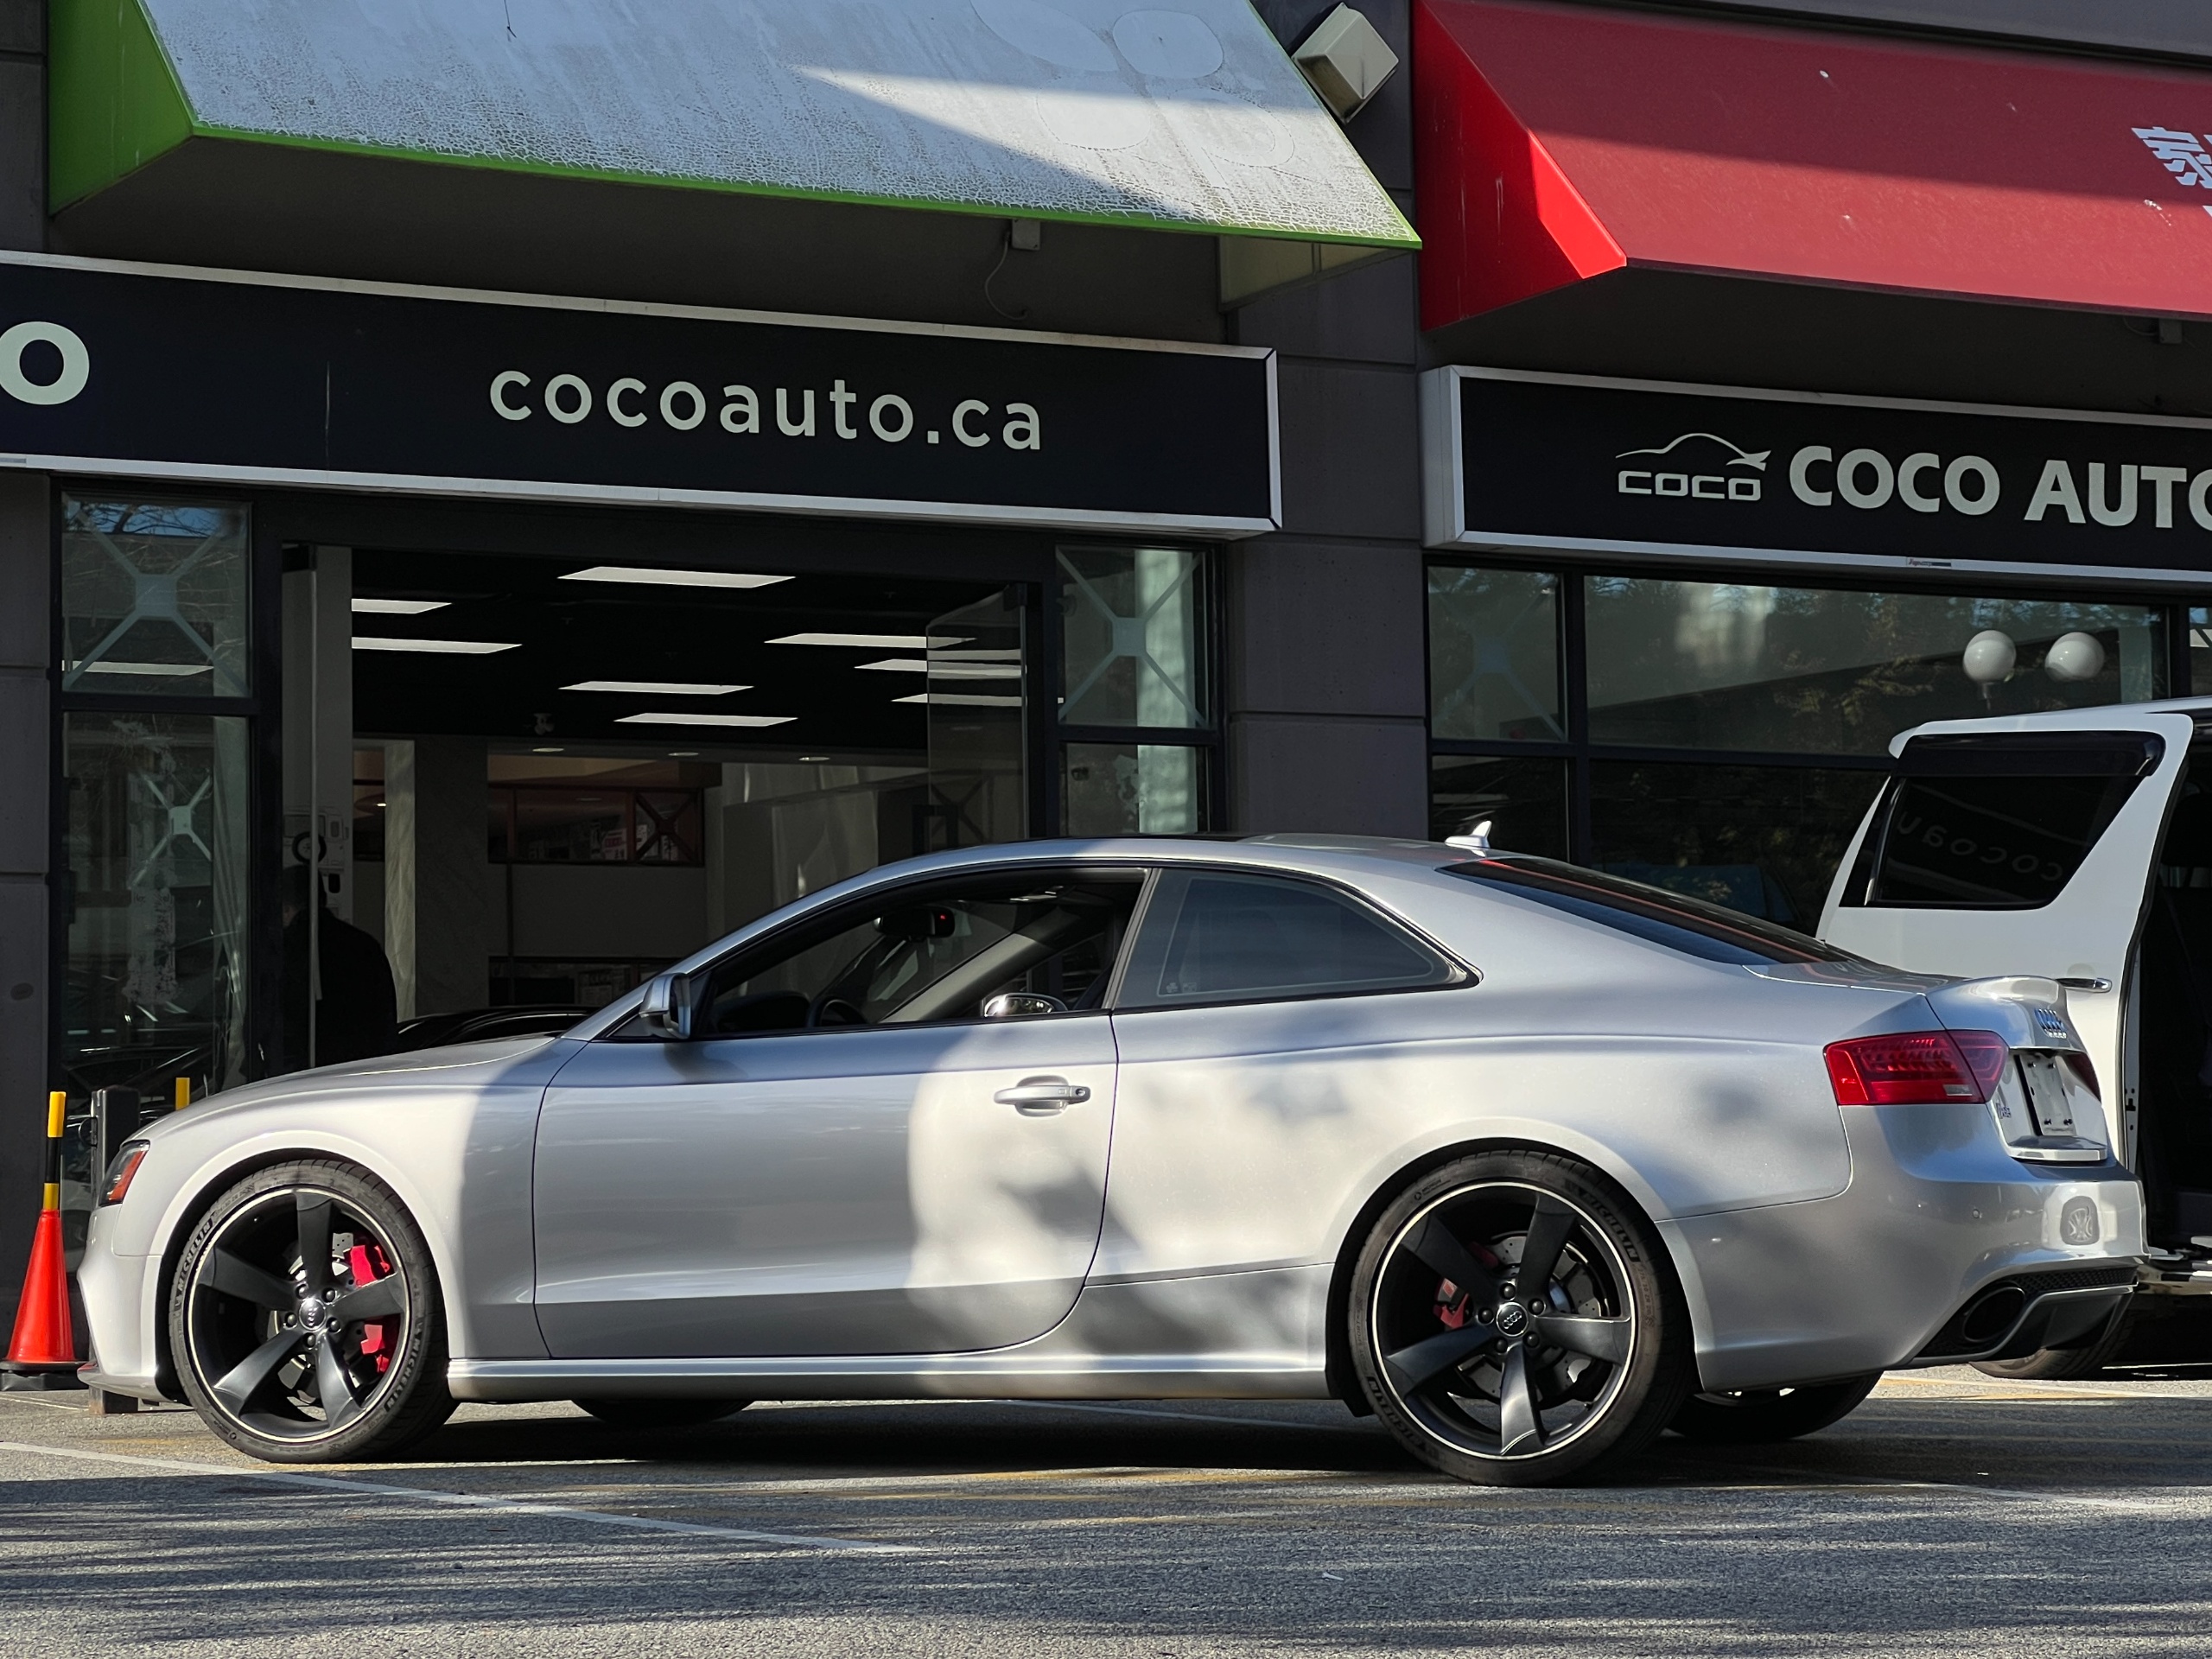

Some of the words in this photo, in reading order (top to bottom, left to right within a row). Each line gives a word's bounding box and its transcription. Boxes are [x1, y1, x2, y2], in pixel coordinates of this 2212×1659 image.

[490, 370, 1041, 450] cocoauto.ca
[1618, 470, 1761, 501] COCO
[1789, 445, 2000, 516] COCO
